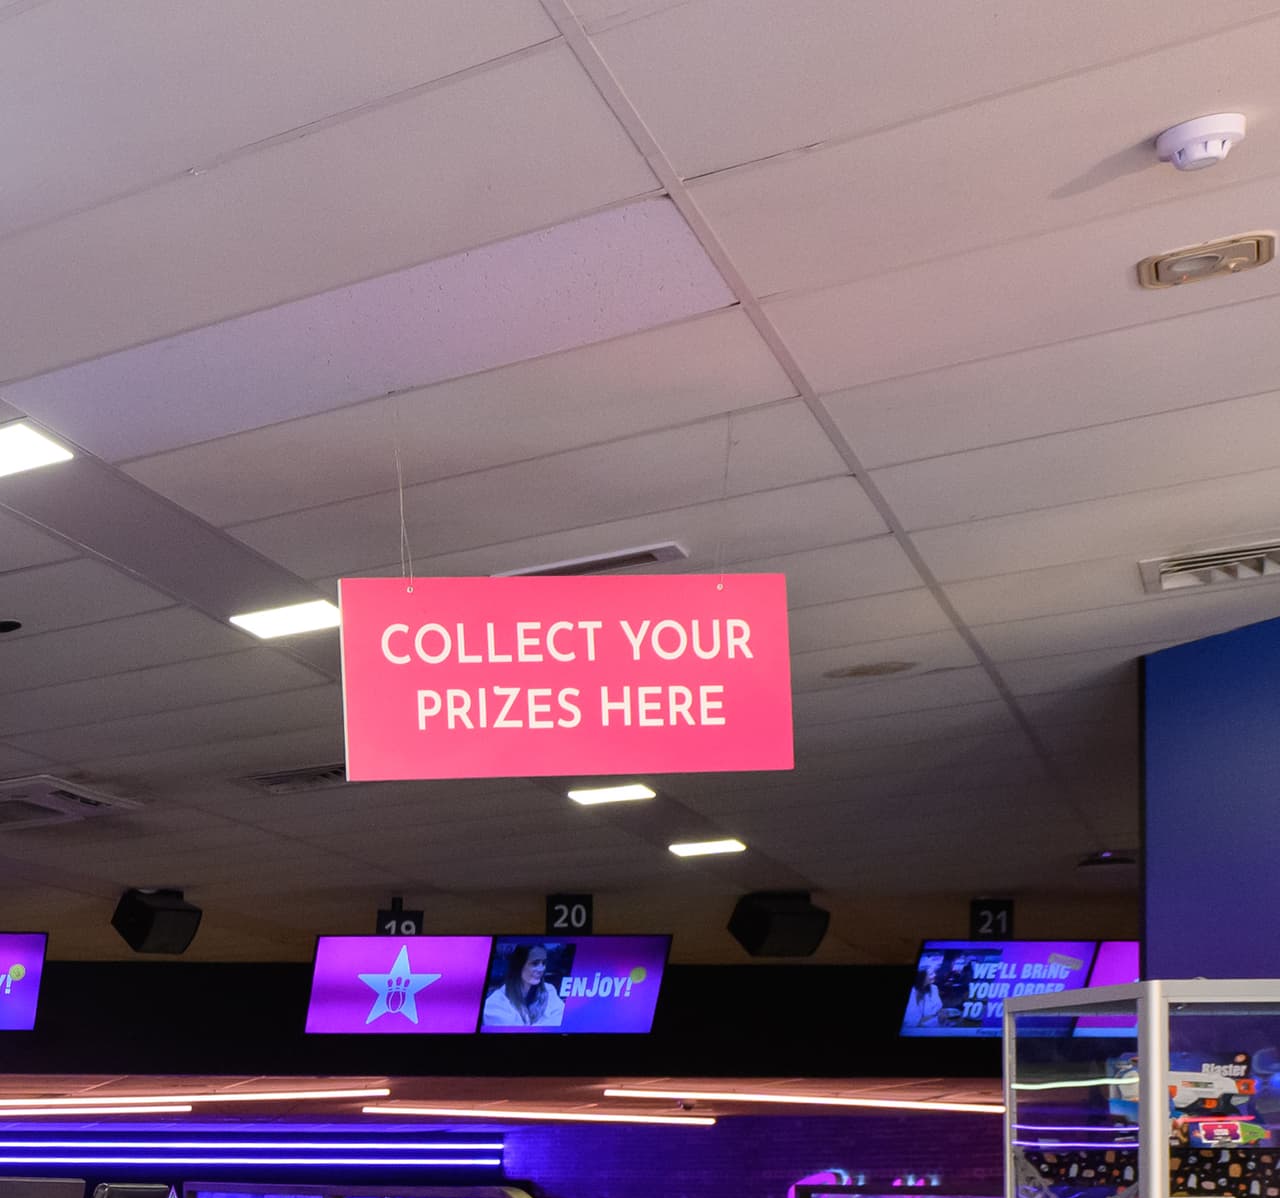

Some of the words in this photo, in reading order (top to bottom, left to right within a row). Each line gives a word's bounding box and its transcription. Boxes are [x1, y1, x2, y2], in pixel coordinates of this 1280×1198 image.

[380, 620, 603, 665] COLLECT
[620, 618, 755, 661] YOUR
[416, 685, 582, 730] PRIZES
[600, 685, 727, 727] HERE
[553, 904, 587, 928] 20
[978, 910, 1008, 934] 21
[972, 961, 1017, 980] WE'LL
[967, 982, 1010, 1000] YOUR
[961, 1001, 983, 1018] TO
[986, 1001, 1005, 1018] YO
